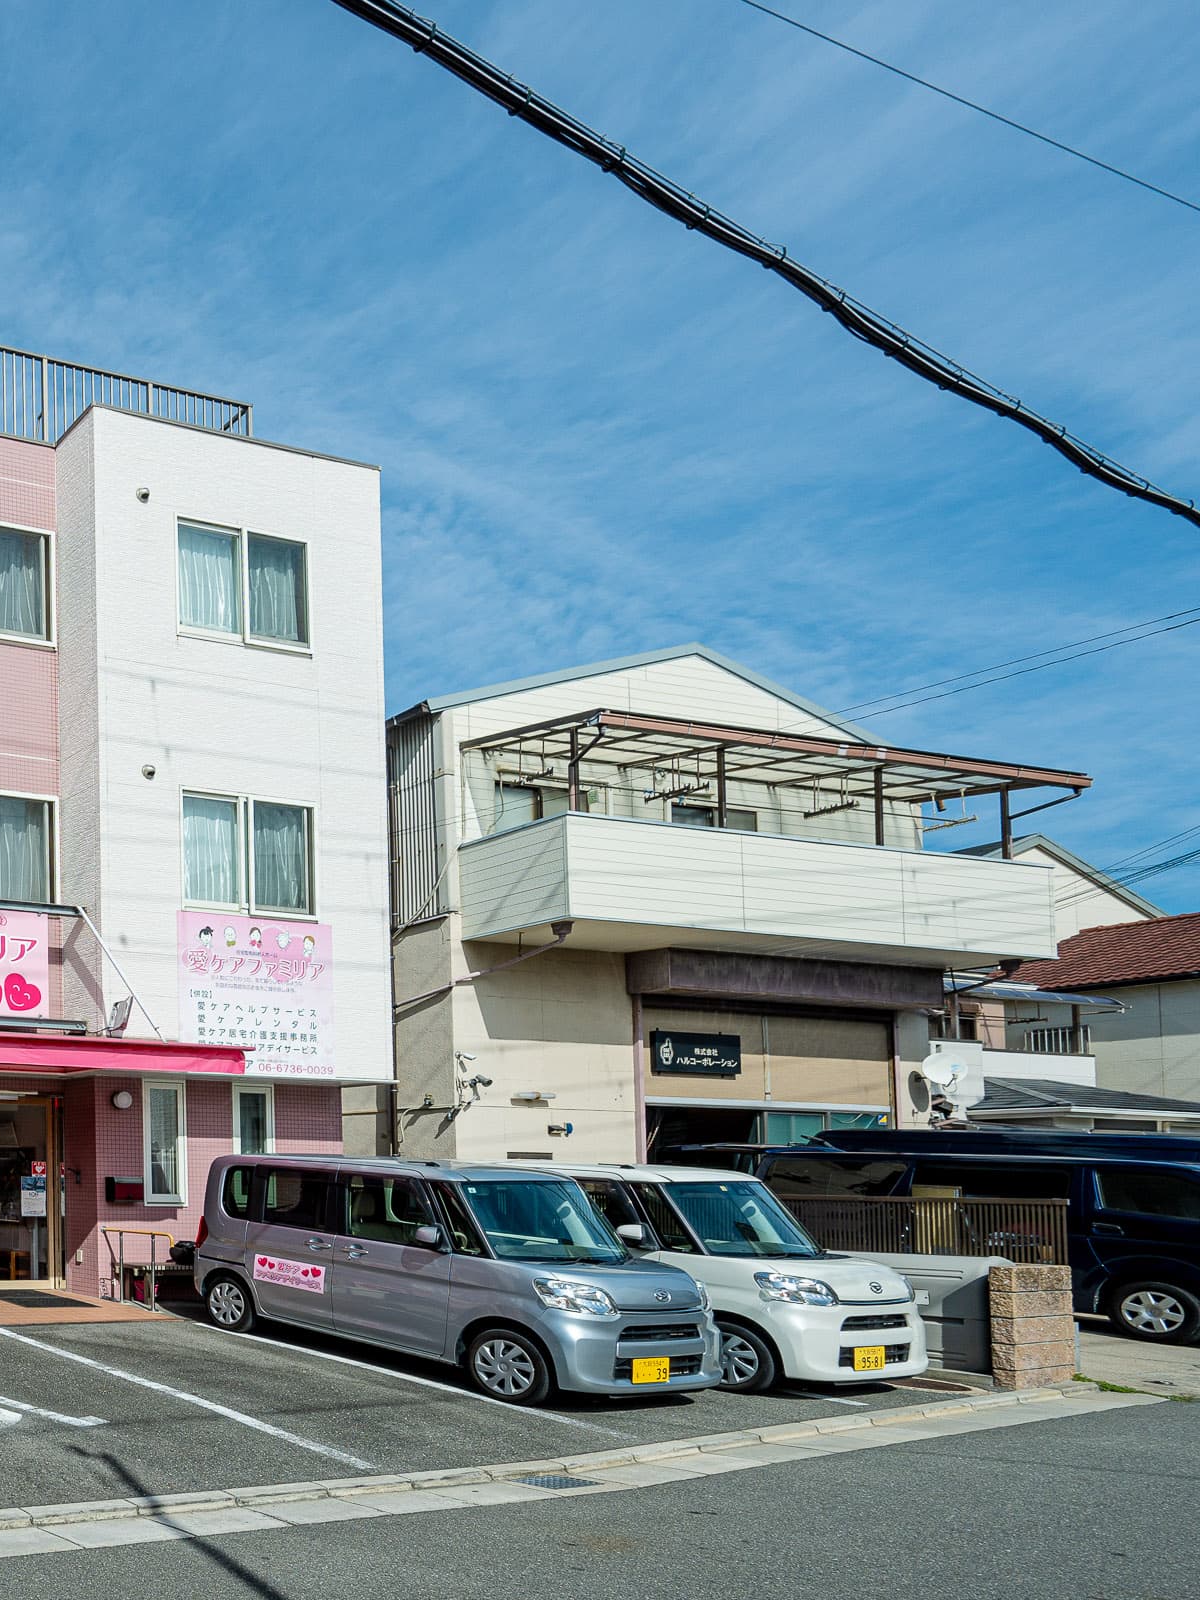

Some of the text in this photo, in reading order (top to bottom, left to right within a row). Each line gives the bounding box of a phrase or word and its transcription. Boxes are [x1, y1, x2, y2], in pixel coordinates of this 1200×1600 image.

[188, 950, 325, 981] 愛ケアファミリア
[694, 1047, 719, 1056] 株式会社
[676, 1057, 738, 1068] ハルコーポレーション
[258, 1063, 334, 1075] 06-6736-0039
